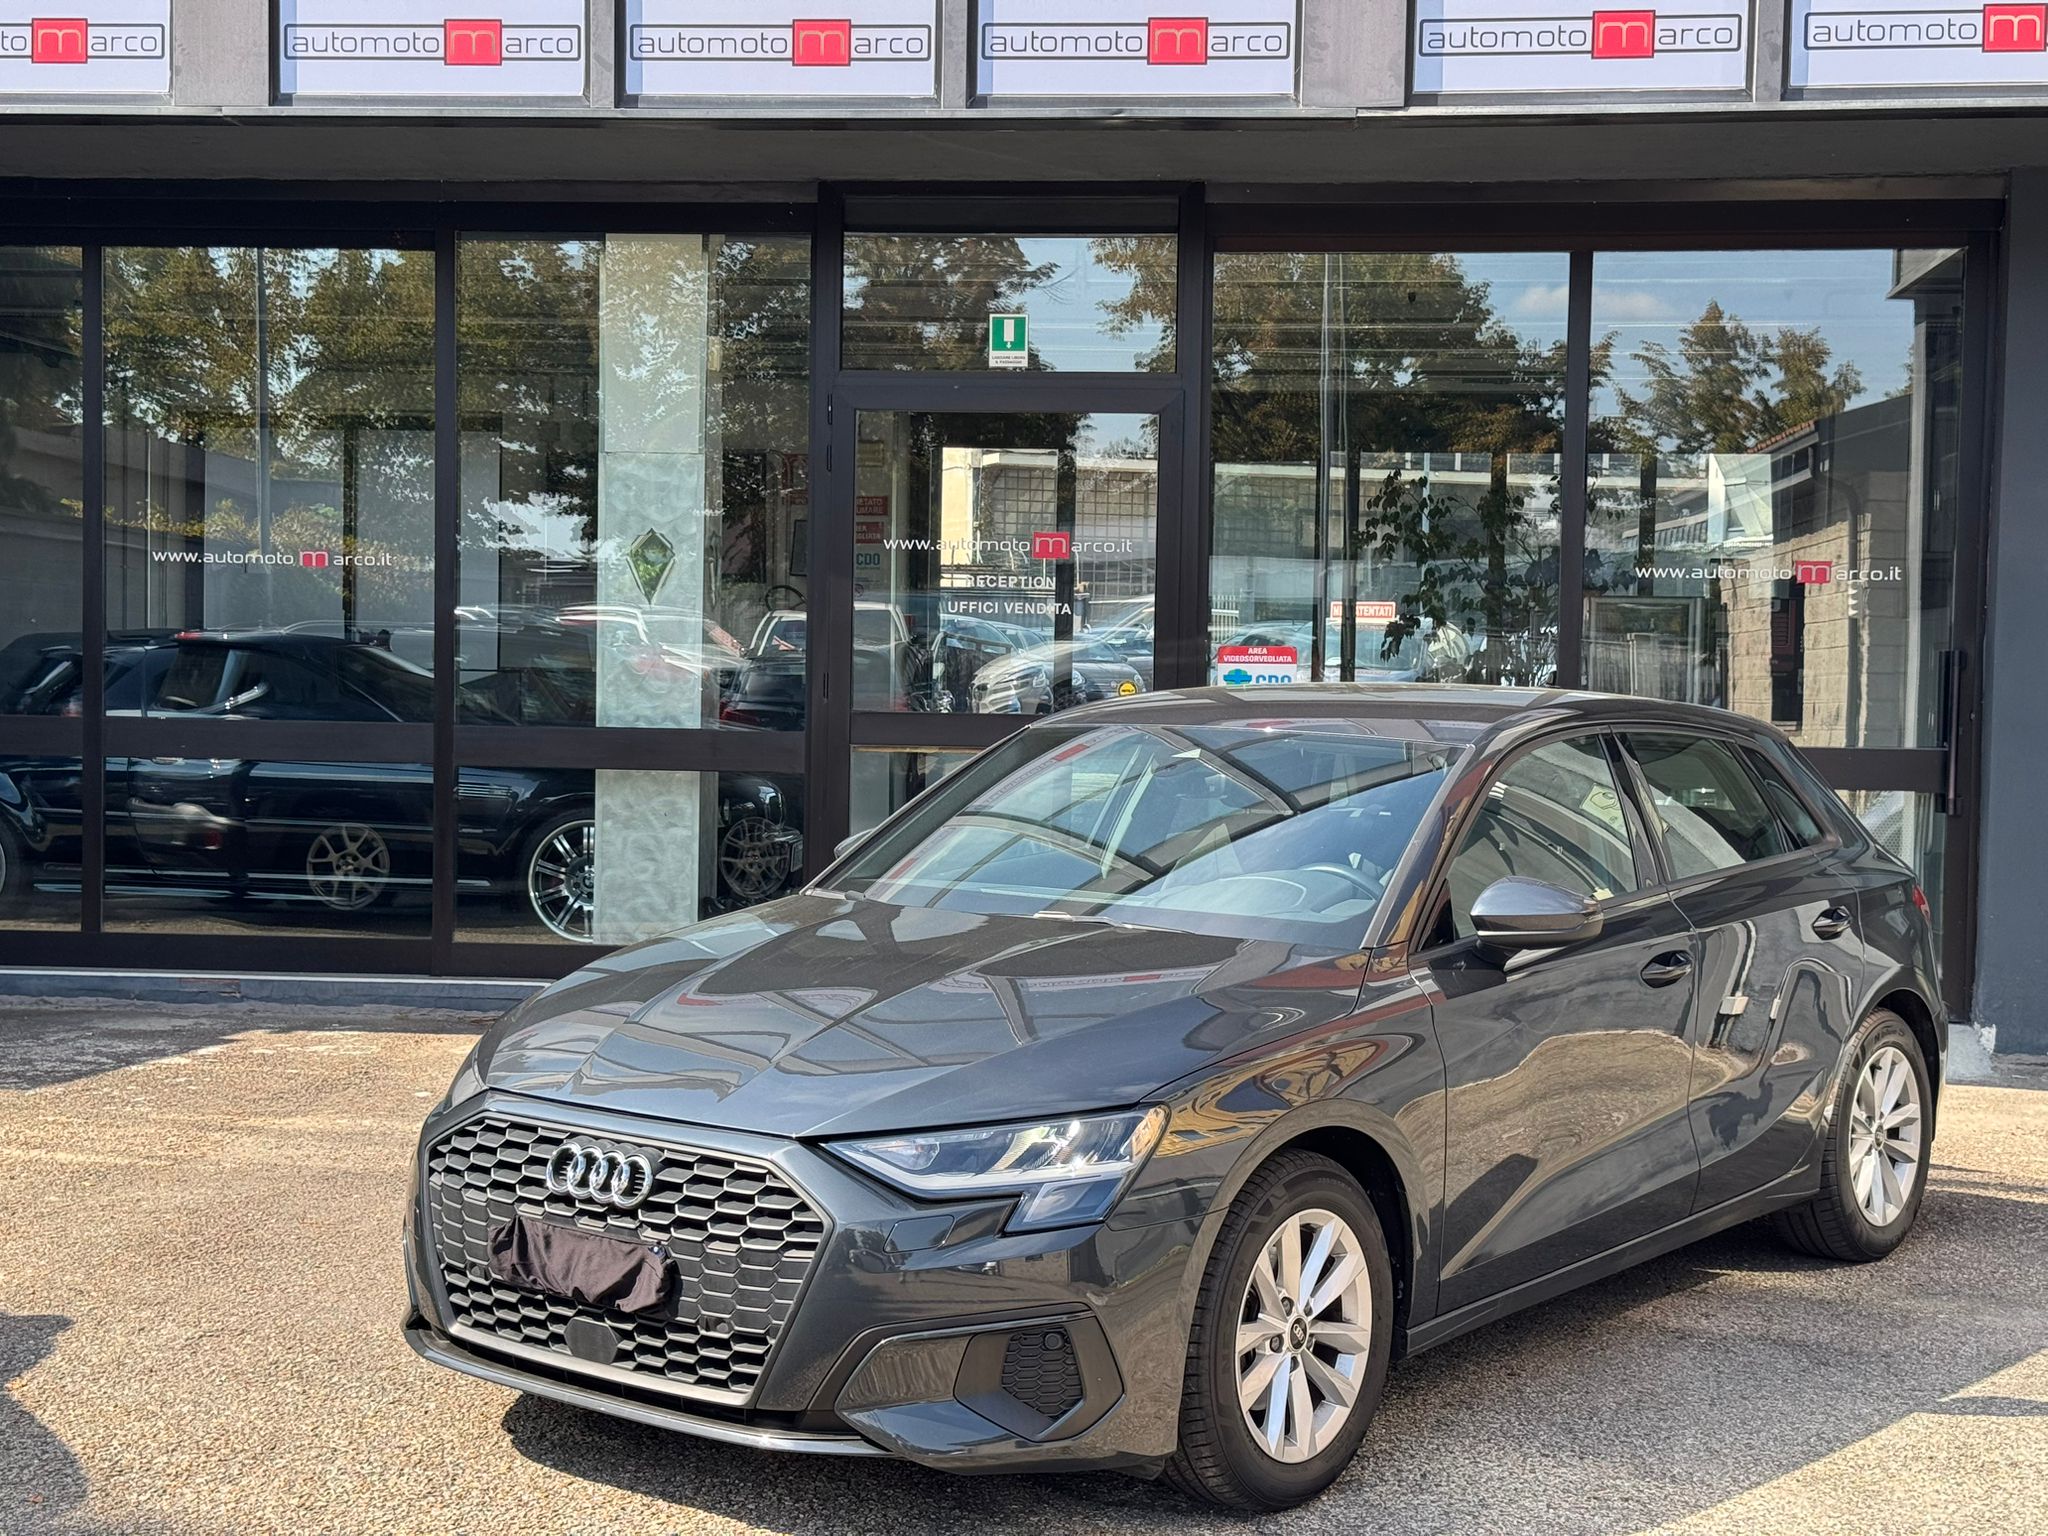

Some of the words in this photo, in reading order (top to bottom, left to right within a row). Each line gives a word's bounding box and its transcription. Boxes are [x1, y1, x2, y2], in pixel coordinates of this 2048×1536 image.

[967, 576, 1056, 588] RECEPTION
[948, 601, 999, 614] UFFICI
[1004, 602, 1072, 615] VENDITA
[1248, 647, 1267, 655] AREA
